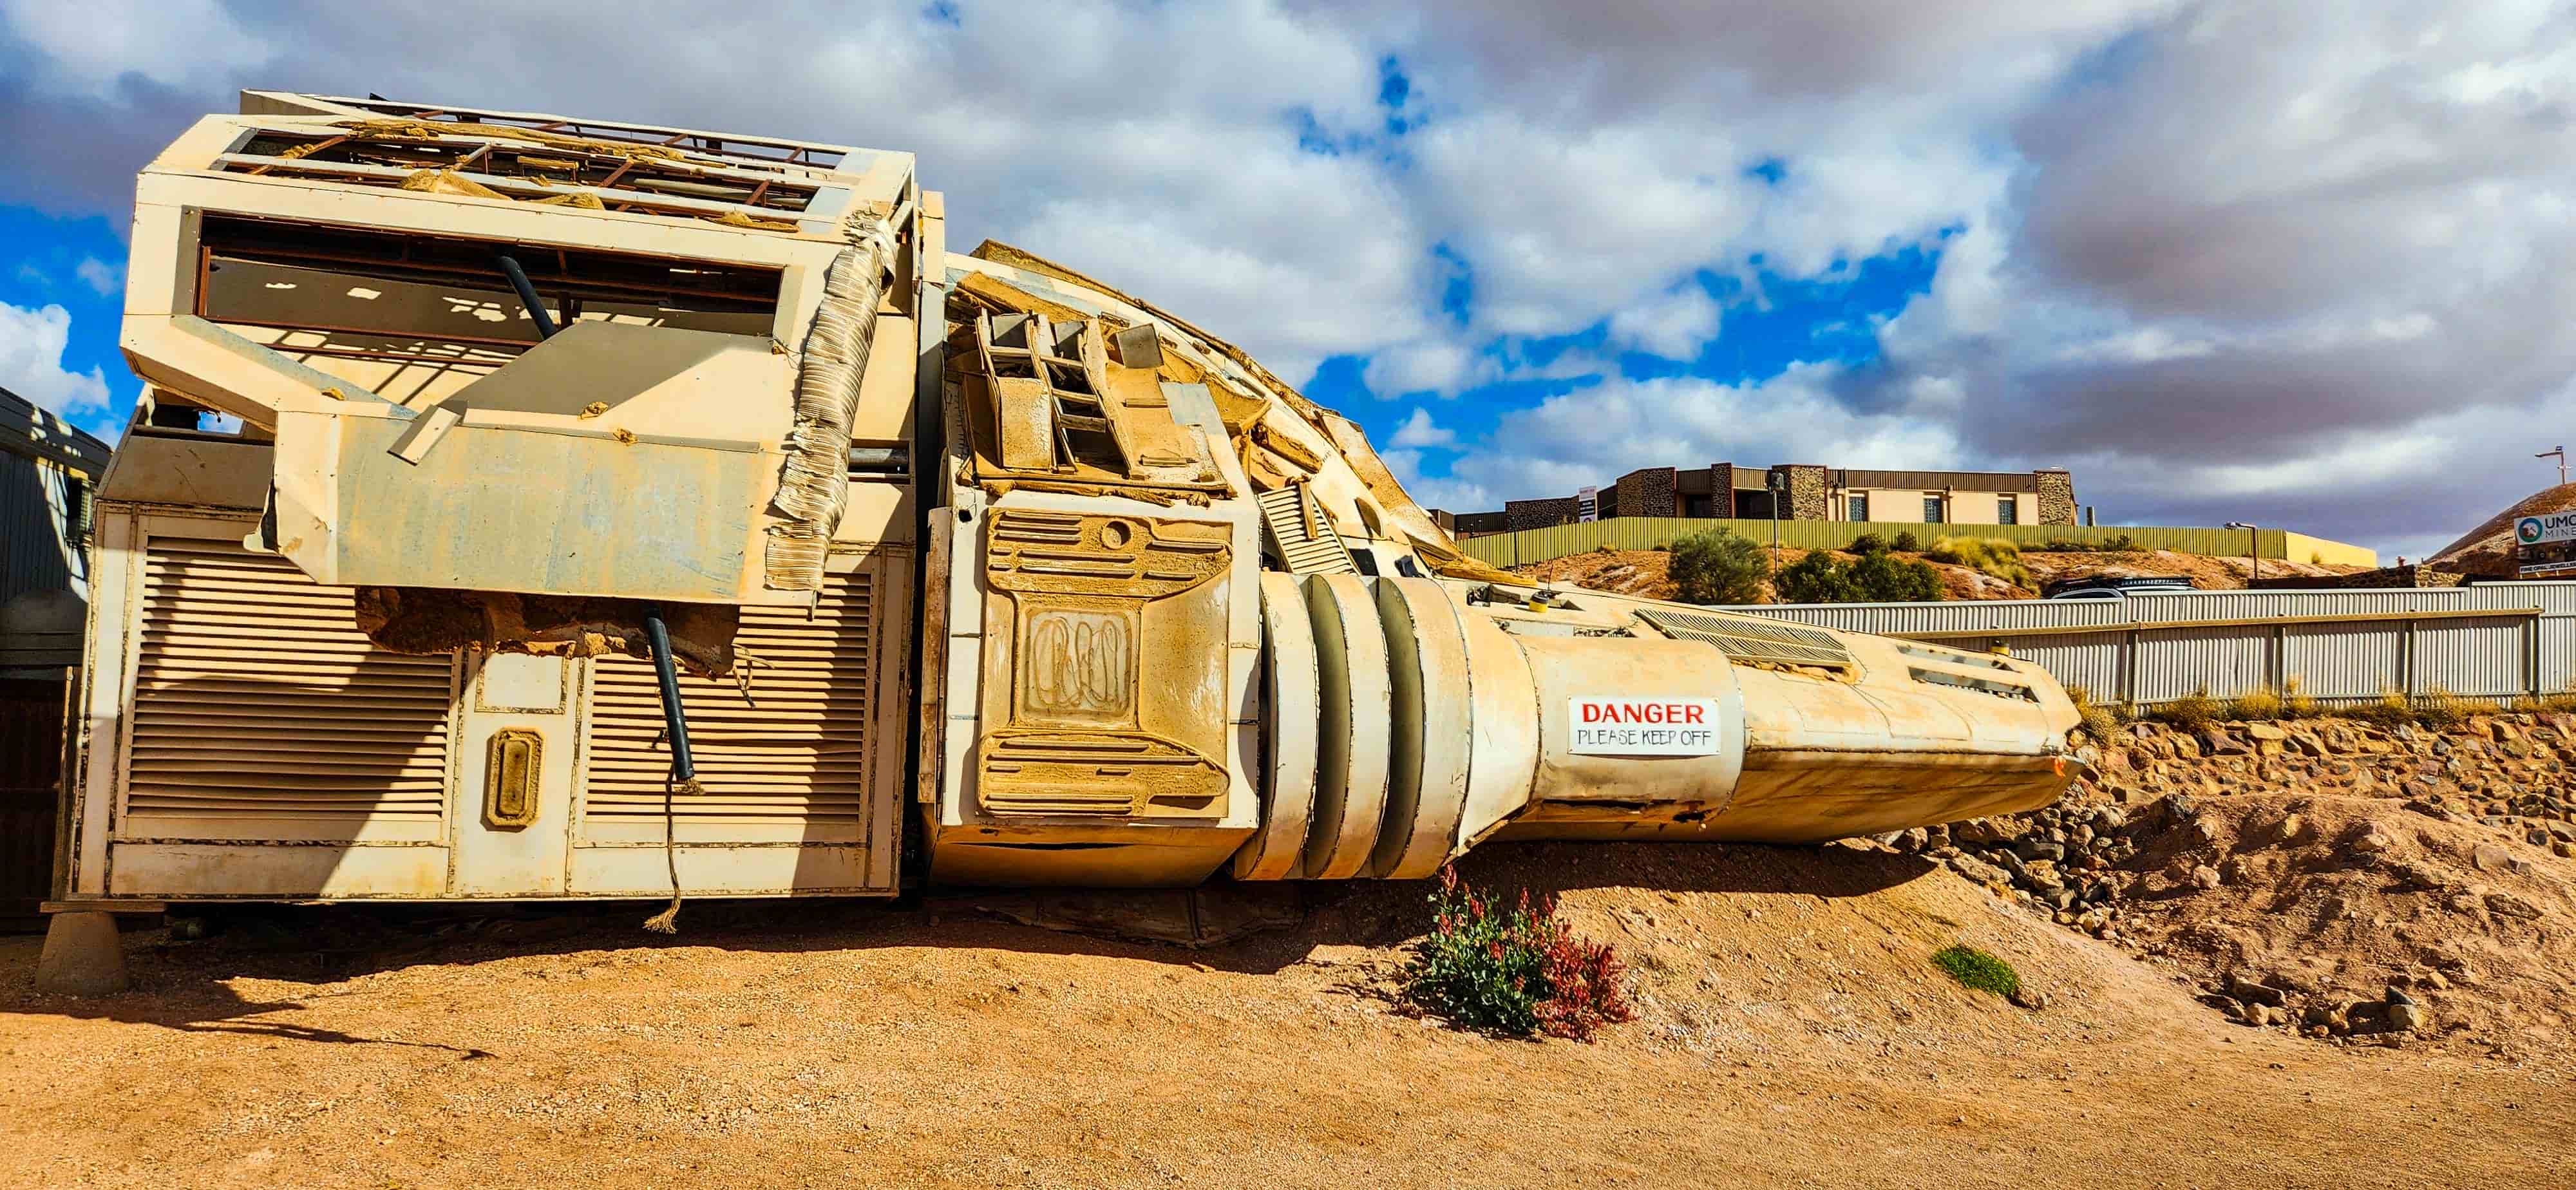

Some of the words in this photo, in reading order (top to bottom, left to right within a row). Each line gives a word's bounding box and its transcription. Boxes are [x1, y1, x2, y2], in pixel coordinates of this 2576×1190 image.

[1582, 703, 1705, 724] DANGER
[1577, 730, 1637, 746] PLEASE
[1642, 730, 1676, 746] KEEP
[1680, 730, 1711, 746] OFF
